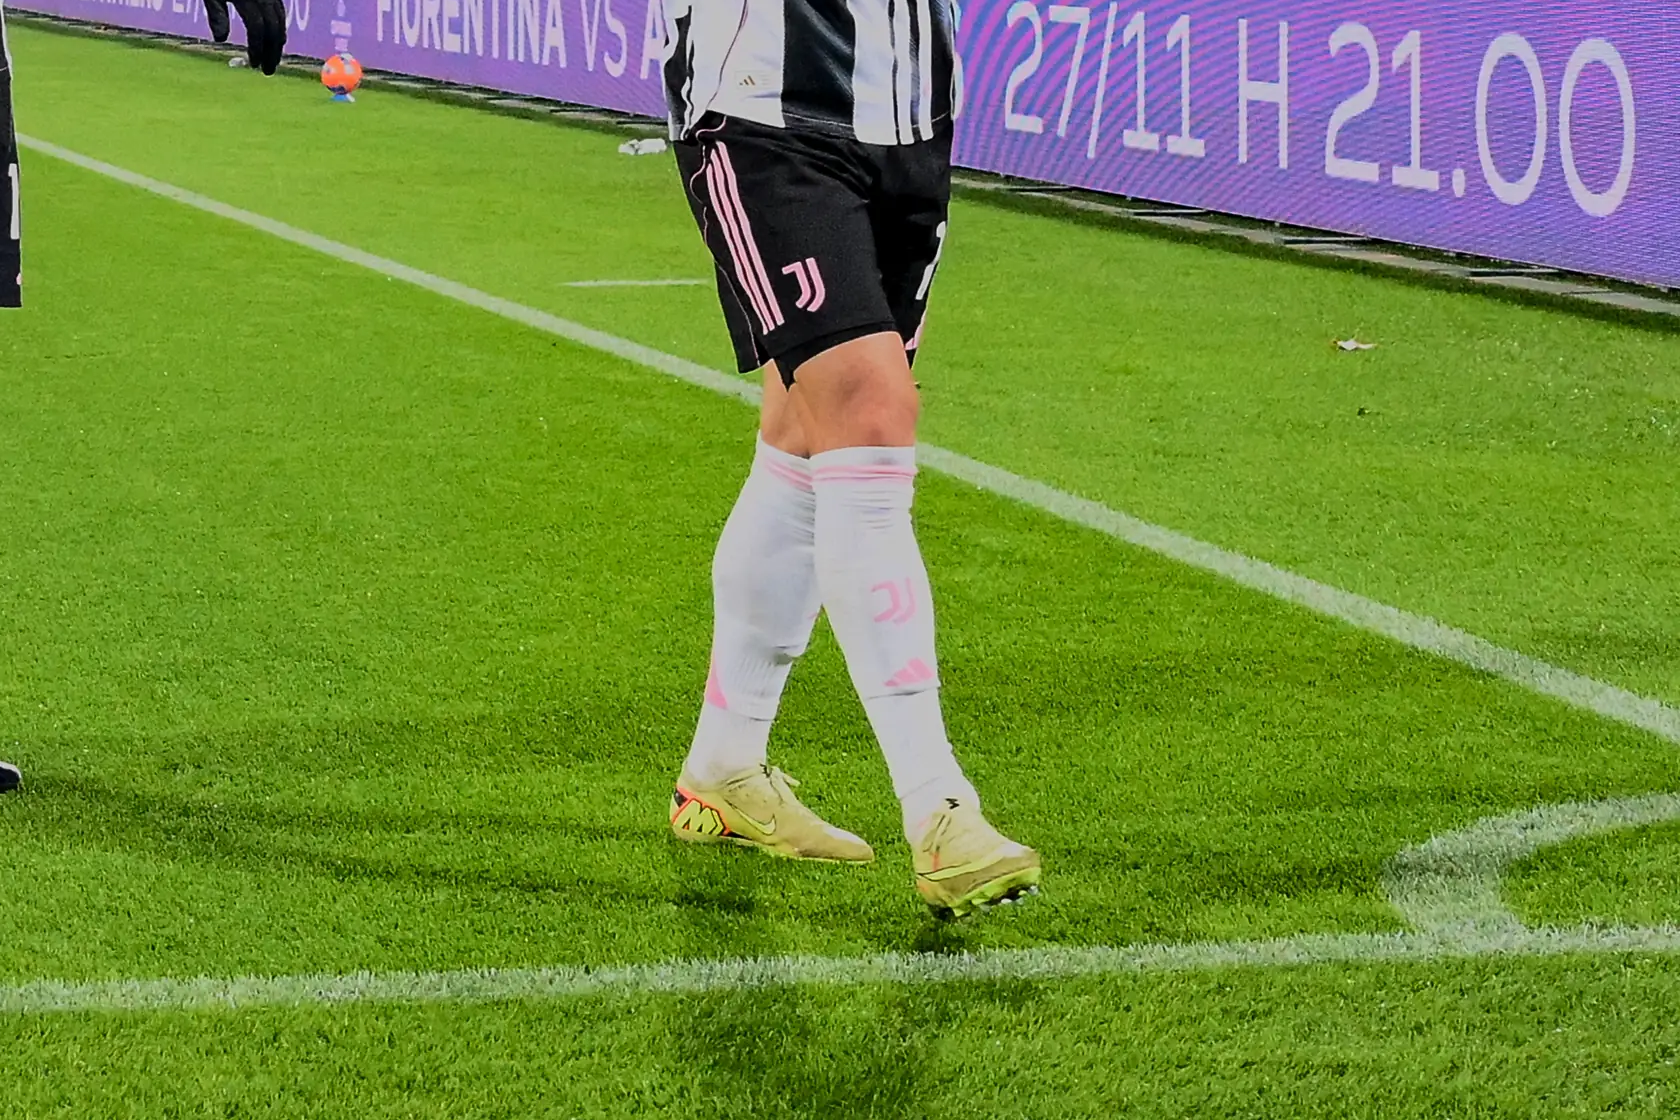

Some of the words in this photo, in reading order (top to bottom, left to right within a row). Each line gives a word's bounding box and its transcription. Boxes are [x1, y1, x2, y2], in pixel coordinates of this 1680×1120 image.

[1004, 0, 1207, 161] 27/11
[1237, 18, 1290, 170] H
[1324, 21, 1636, 218] 21.00
